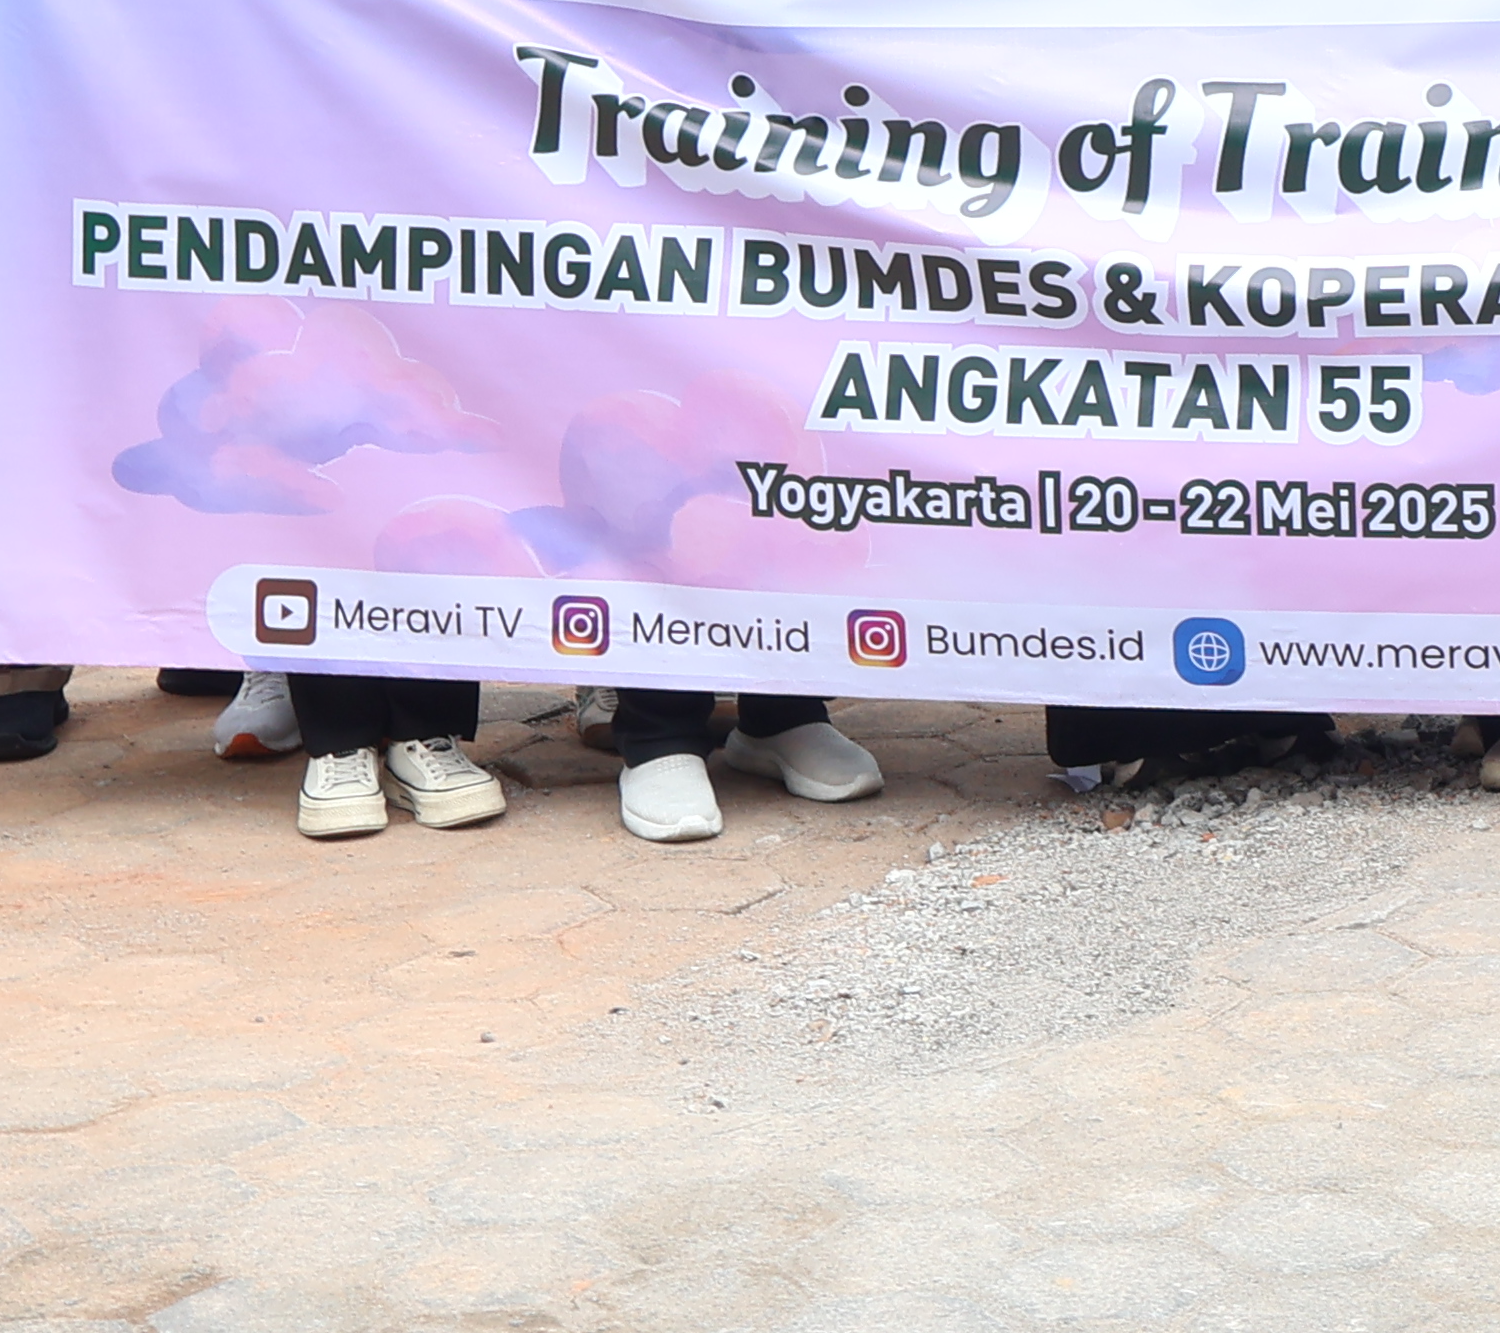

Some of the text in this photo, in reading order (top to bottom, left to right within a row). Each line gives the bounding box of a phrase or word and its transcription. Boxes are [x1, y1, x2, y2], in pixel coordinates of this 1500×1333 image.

[514, 42, 1024, 219] Training
[1056, 78, 1178, 217] of
[80, 209, 712, 305] PENDAMPINGAN
[739, 239, 1078, 321] BUMDES
[1103, 261, 1162, 326] &
[820, 351, 1412, 433] ANGKATAN 55
[743, 463, 1029, 532] Yogyakarta
[1069, 475, 1137, 531] 20
[1181, 478, 1251, 534] 22
[1258, 480, 1356, 536] Mei
[1366, 482, 1496, 536] 2025
[333, 596, 524, 640] Meravi TV
[632, 612, 811, 655] Meravi.id
[927, 623, 1146, 663] Bumdes.id
